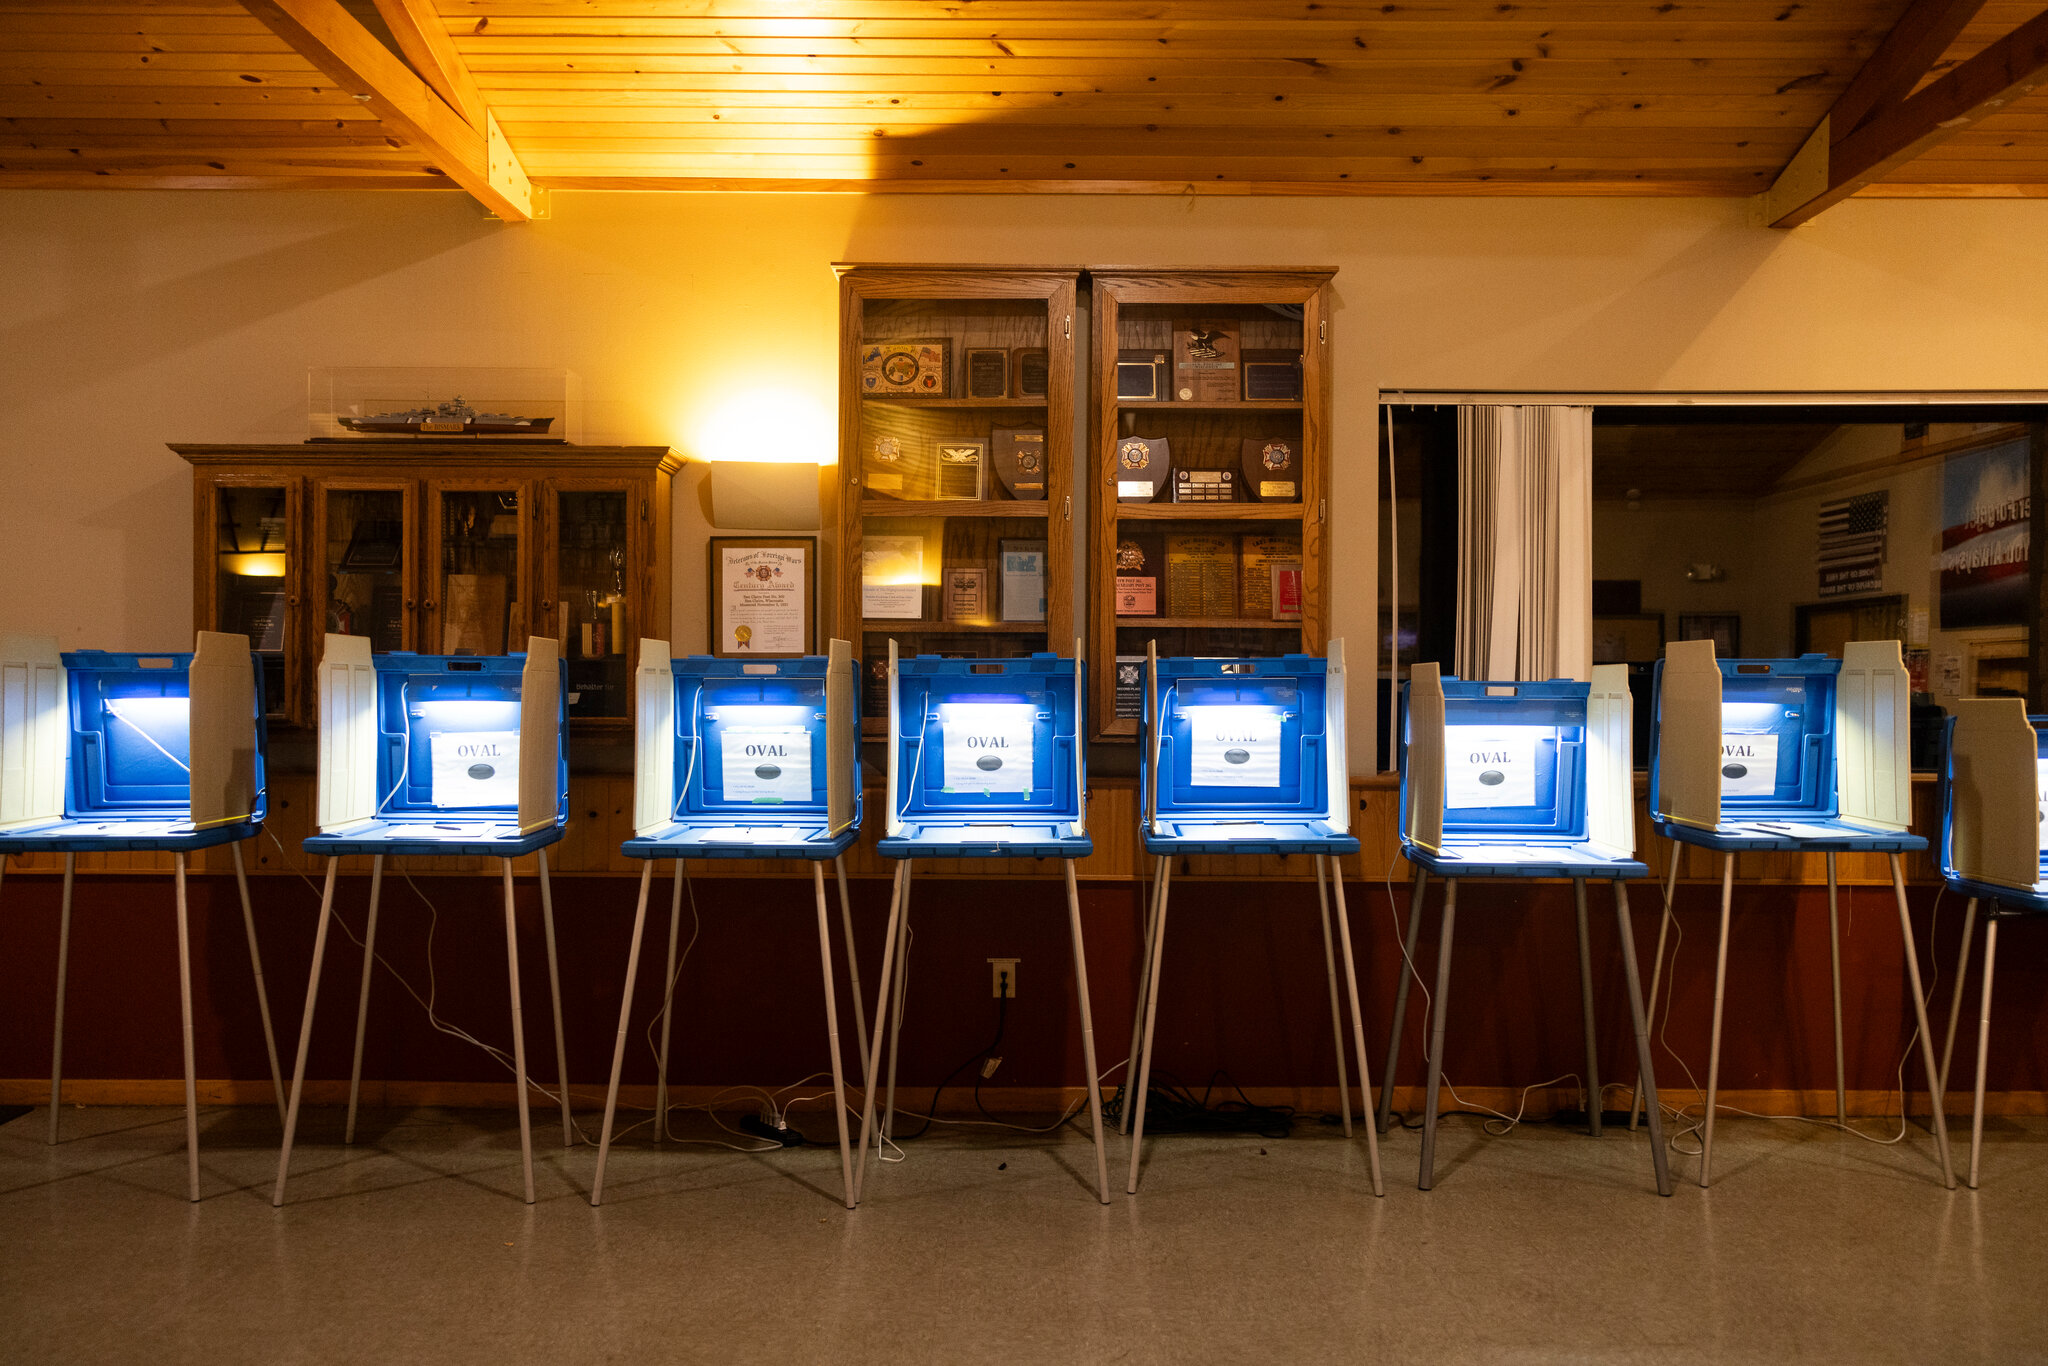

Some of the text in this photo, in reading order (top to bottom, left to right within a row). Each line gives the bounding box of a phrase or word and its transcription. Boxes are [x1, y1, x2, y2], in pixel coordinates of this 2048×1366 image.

[967, 736, 1009, 748] OVAL
[457, 744, 501, 757] OVAL
[745, 744, 788, 757] OVAL
[1721, 745, 1755, 757] VAL
[1470, 751, 1511, 764] OVAL
